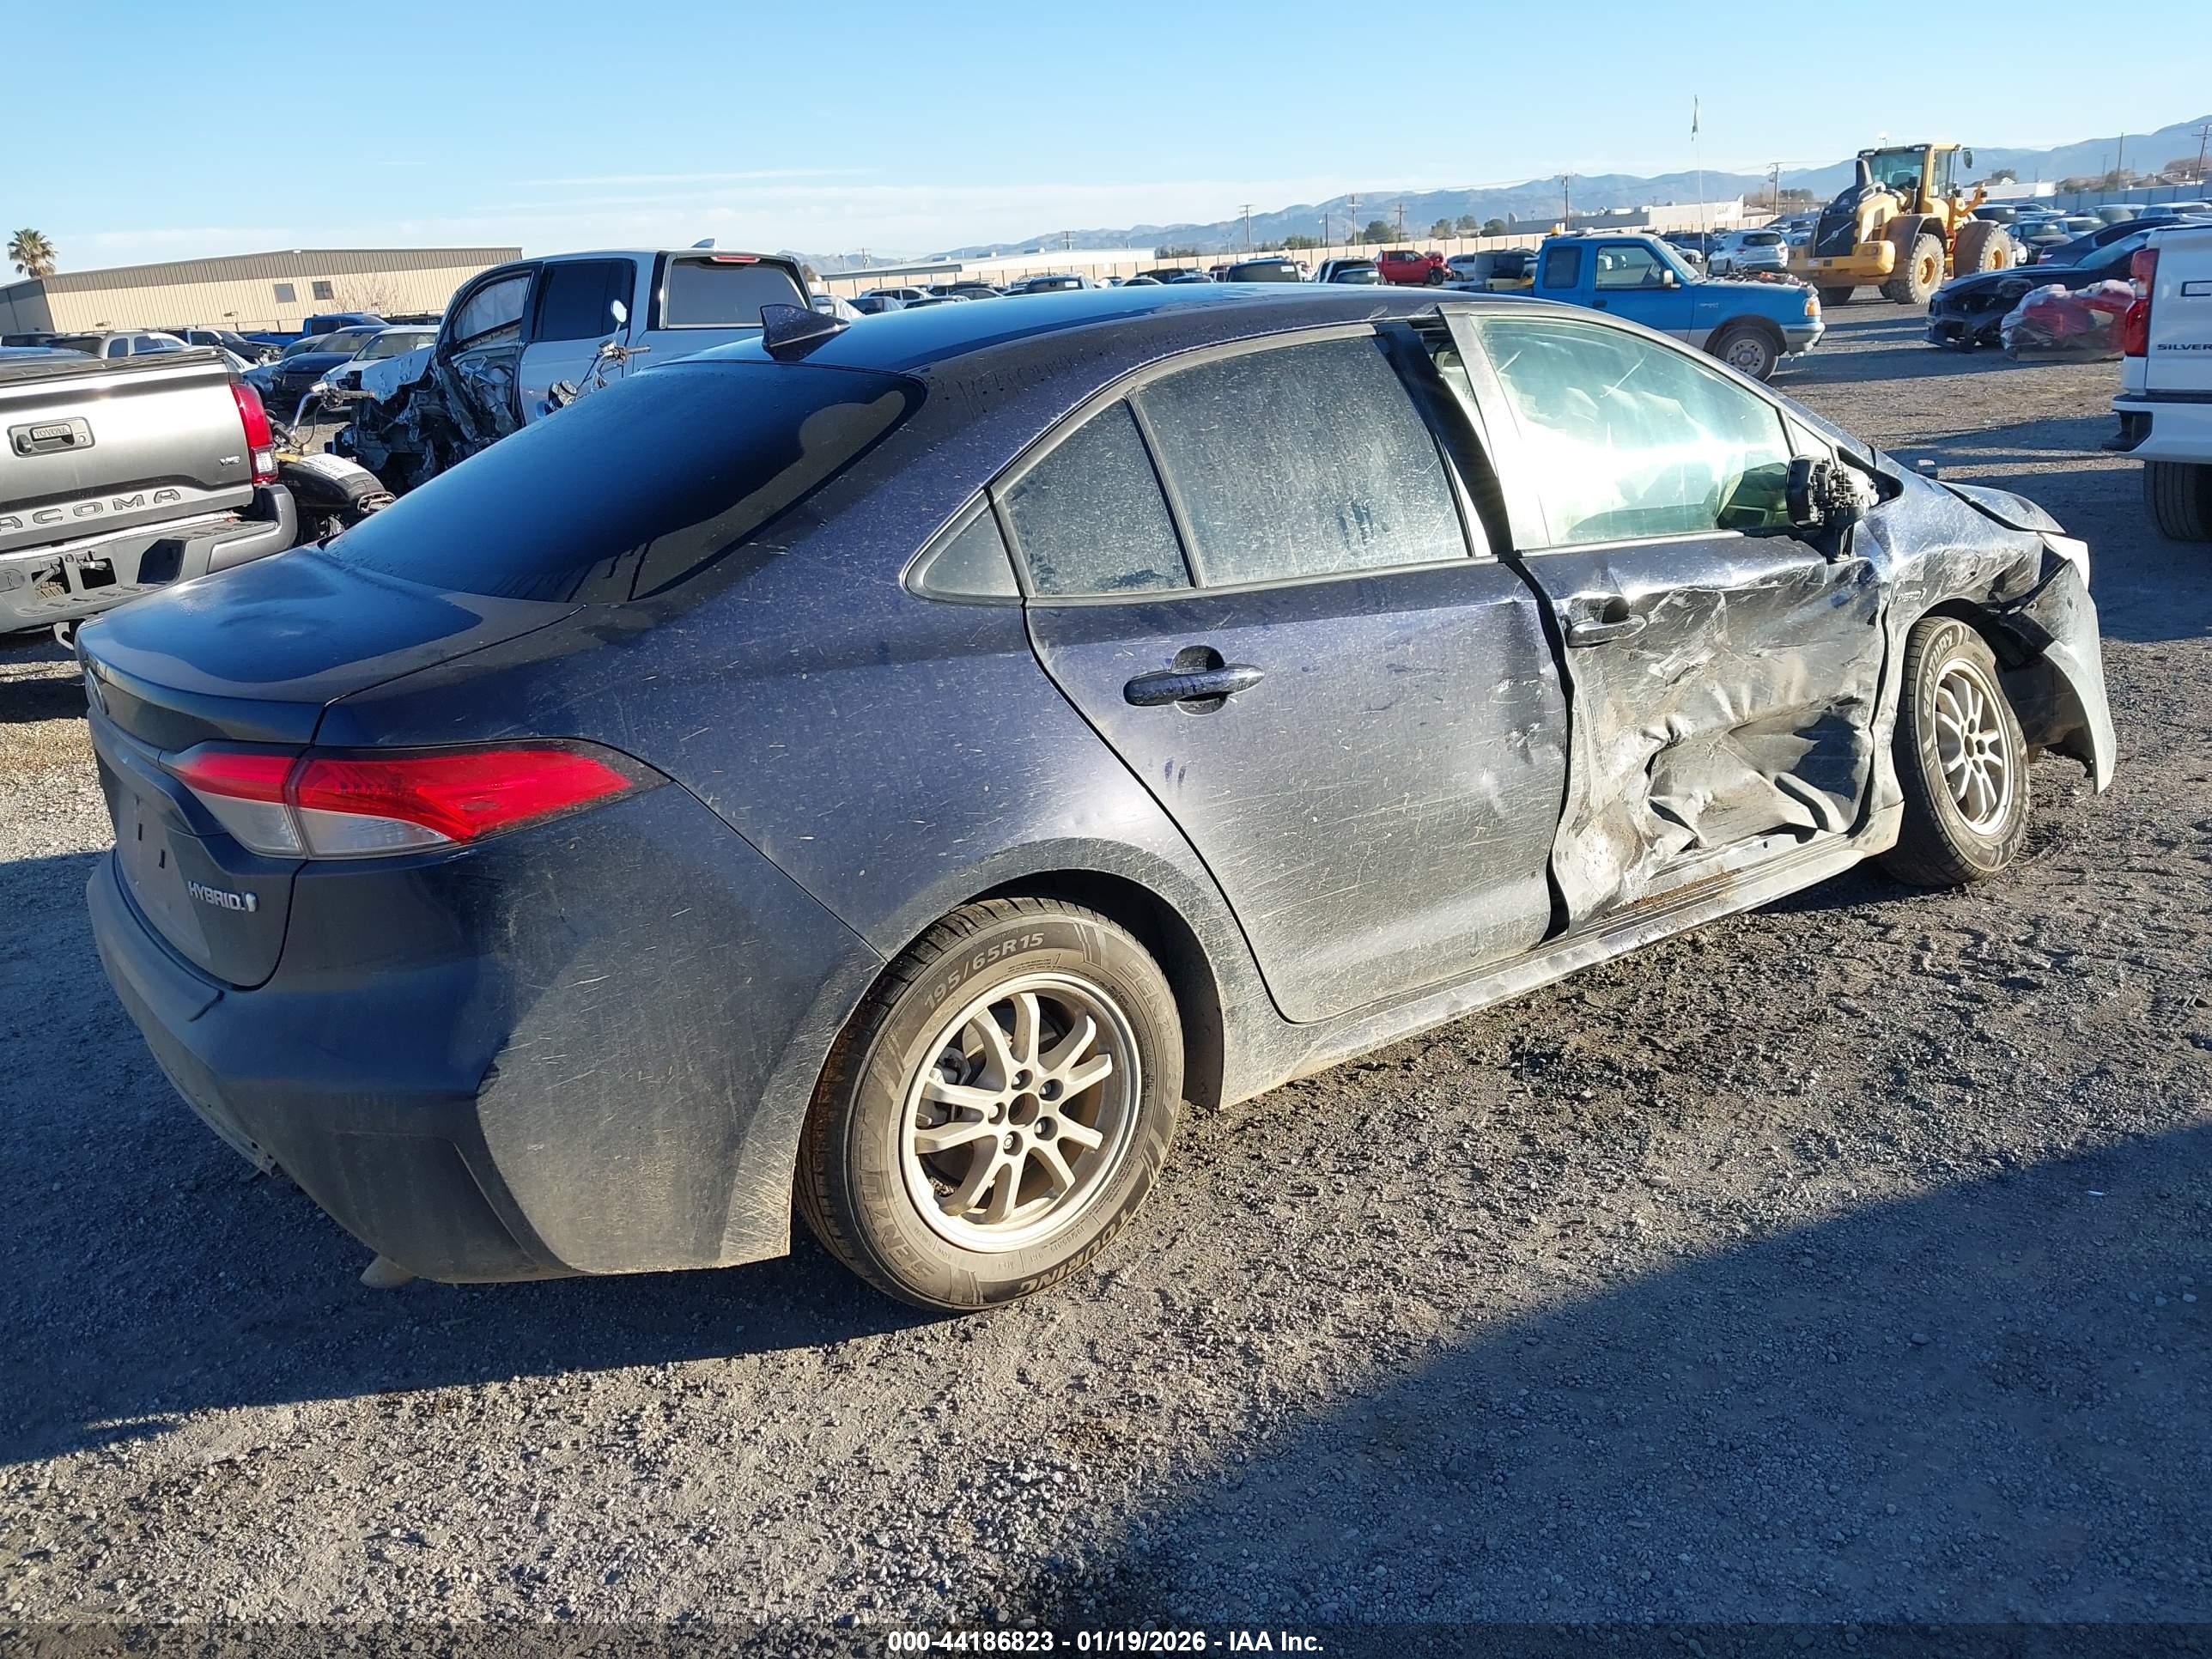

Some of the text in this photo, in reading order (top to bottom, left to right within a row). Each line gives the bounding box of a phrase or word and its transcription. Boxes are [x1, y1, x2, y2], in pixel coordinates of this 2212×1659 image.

[34, 427, 70, 438] TOYOTA
[0, 489, 181, 532] ACOMA
[1923, 629, 1954, 721] SENTURY
[188, 880, 241, 910] HYBRID
[924, 933, 1044, 1010] 195/65R15
[1016, 1209, 1132, 1297] TOURING
